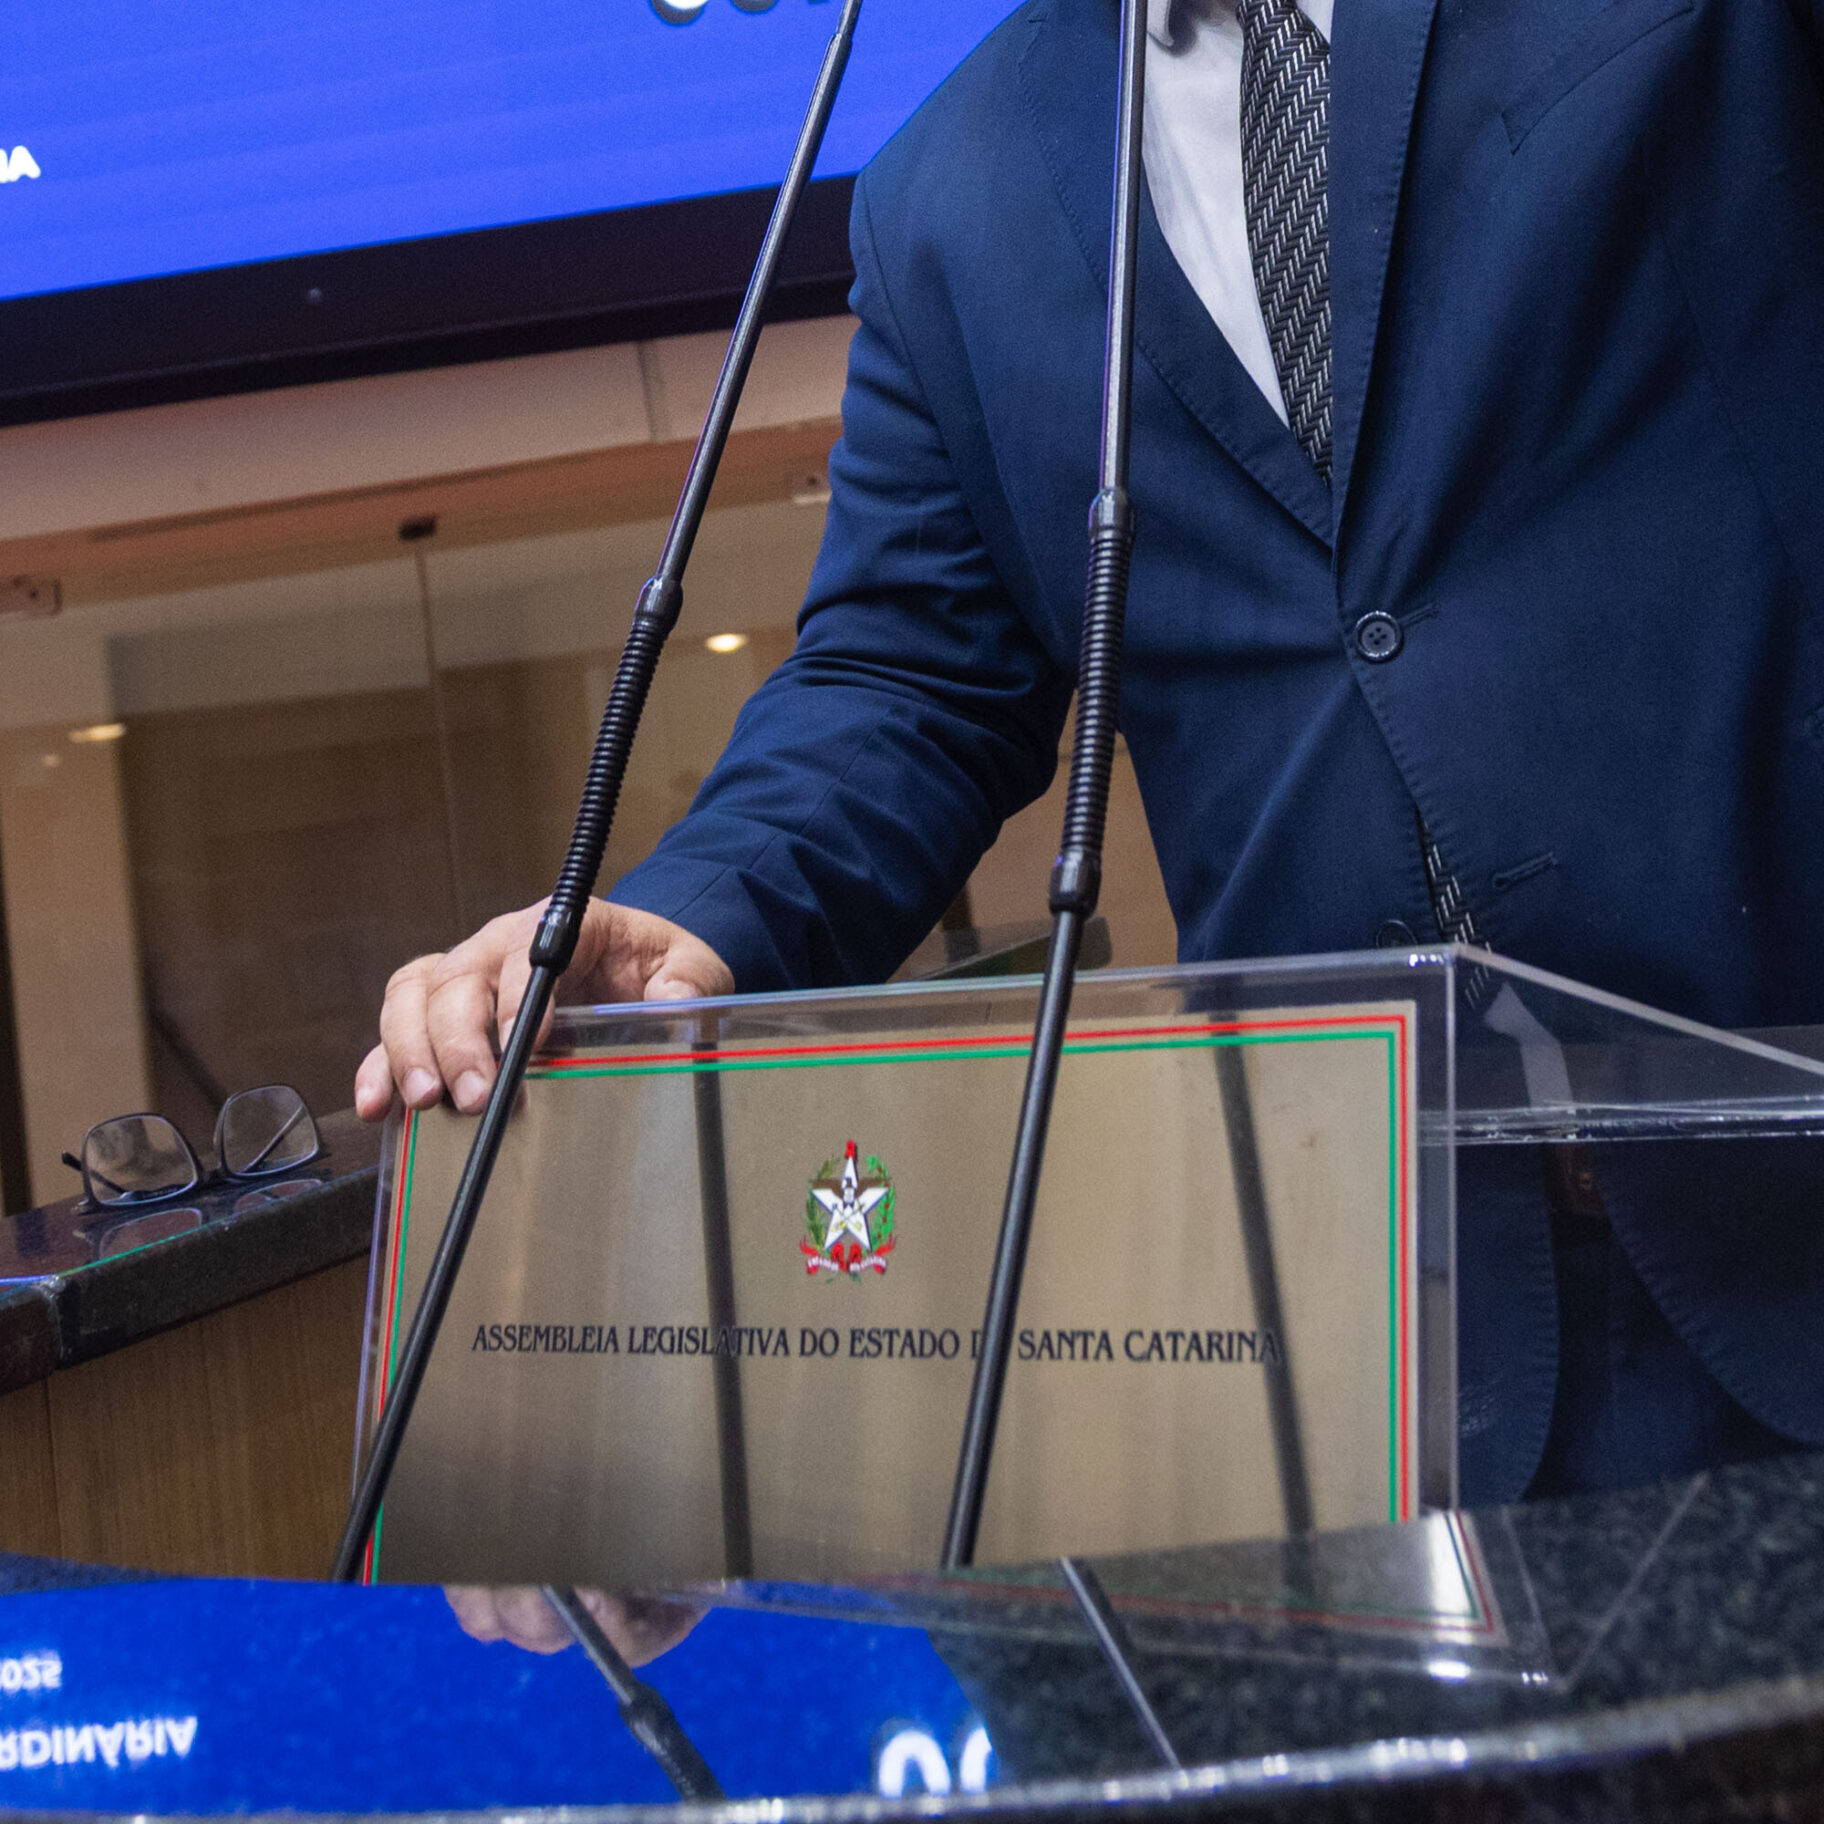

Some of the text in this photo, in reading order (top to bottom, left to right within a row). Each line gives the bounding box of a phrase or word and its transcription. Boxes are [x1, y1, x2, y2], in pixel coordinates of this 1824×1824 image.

[472, 1323, 619, 1354] ASSEMBLEIA
[626, 1325, 791, 1358] LEGISLATIVA
[800, 1327, 840, 1358] DO
[849, 1327, 961, 1360] ESTADO
[1017, 1329, 1115, 1362] SANTA
[1123, 1329, 1277, 1363] CATARINA
